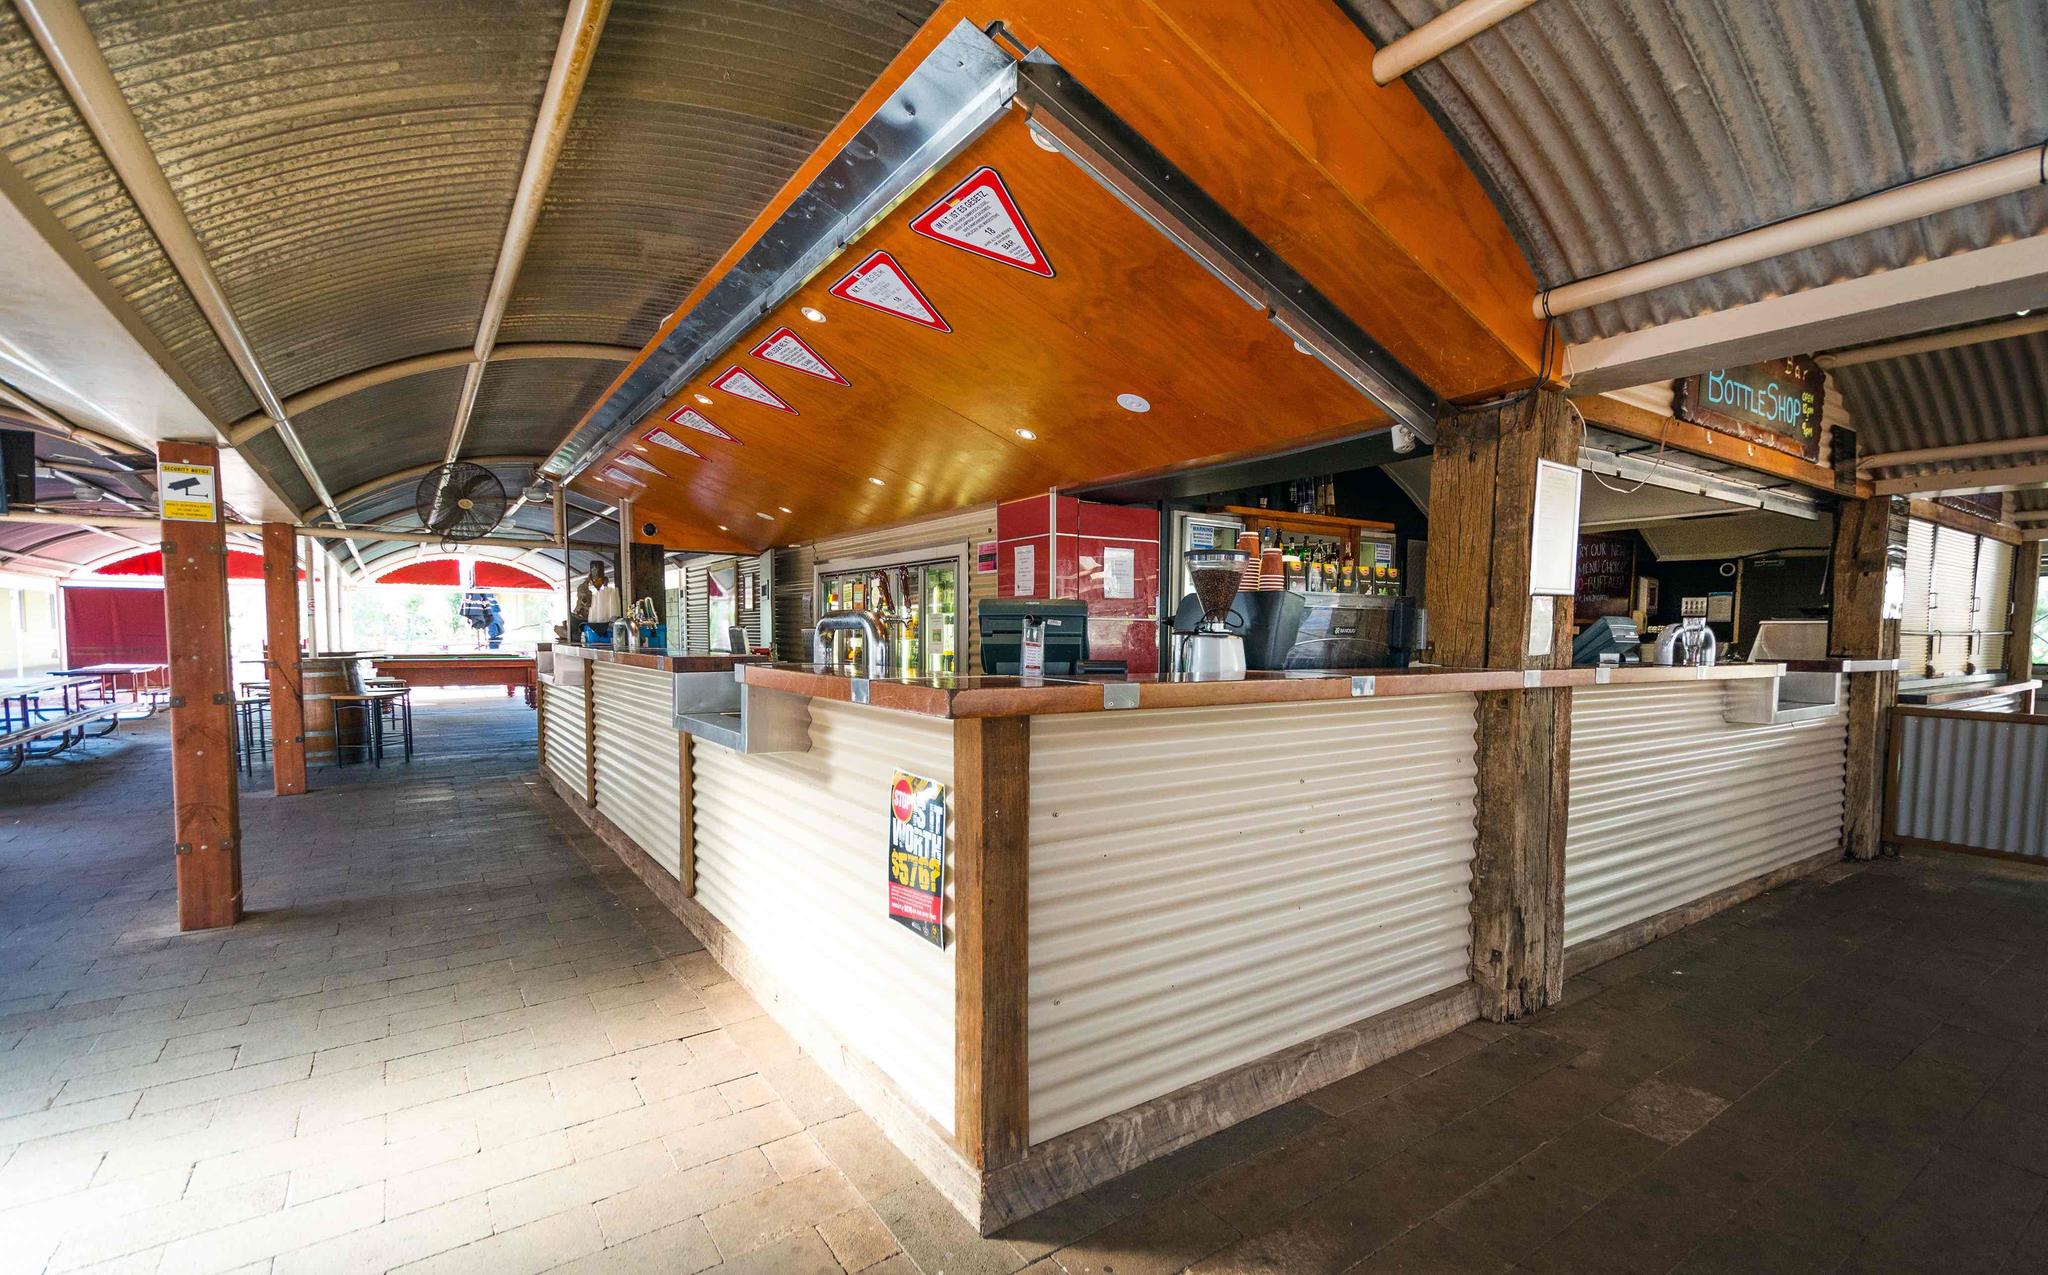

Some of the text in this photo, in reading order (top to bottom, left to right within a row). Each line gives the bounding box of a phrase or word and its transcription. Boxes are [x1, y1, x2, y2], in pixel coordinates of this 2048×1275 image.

[984, 227, 996, 236] 18
[894, 789, 912, 810] STOP
[929, 803, 943, 835] IT
[893, 817, 942, 863] WORTH
[892, 848, 941, 893] $576?
